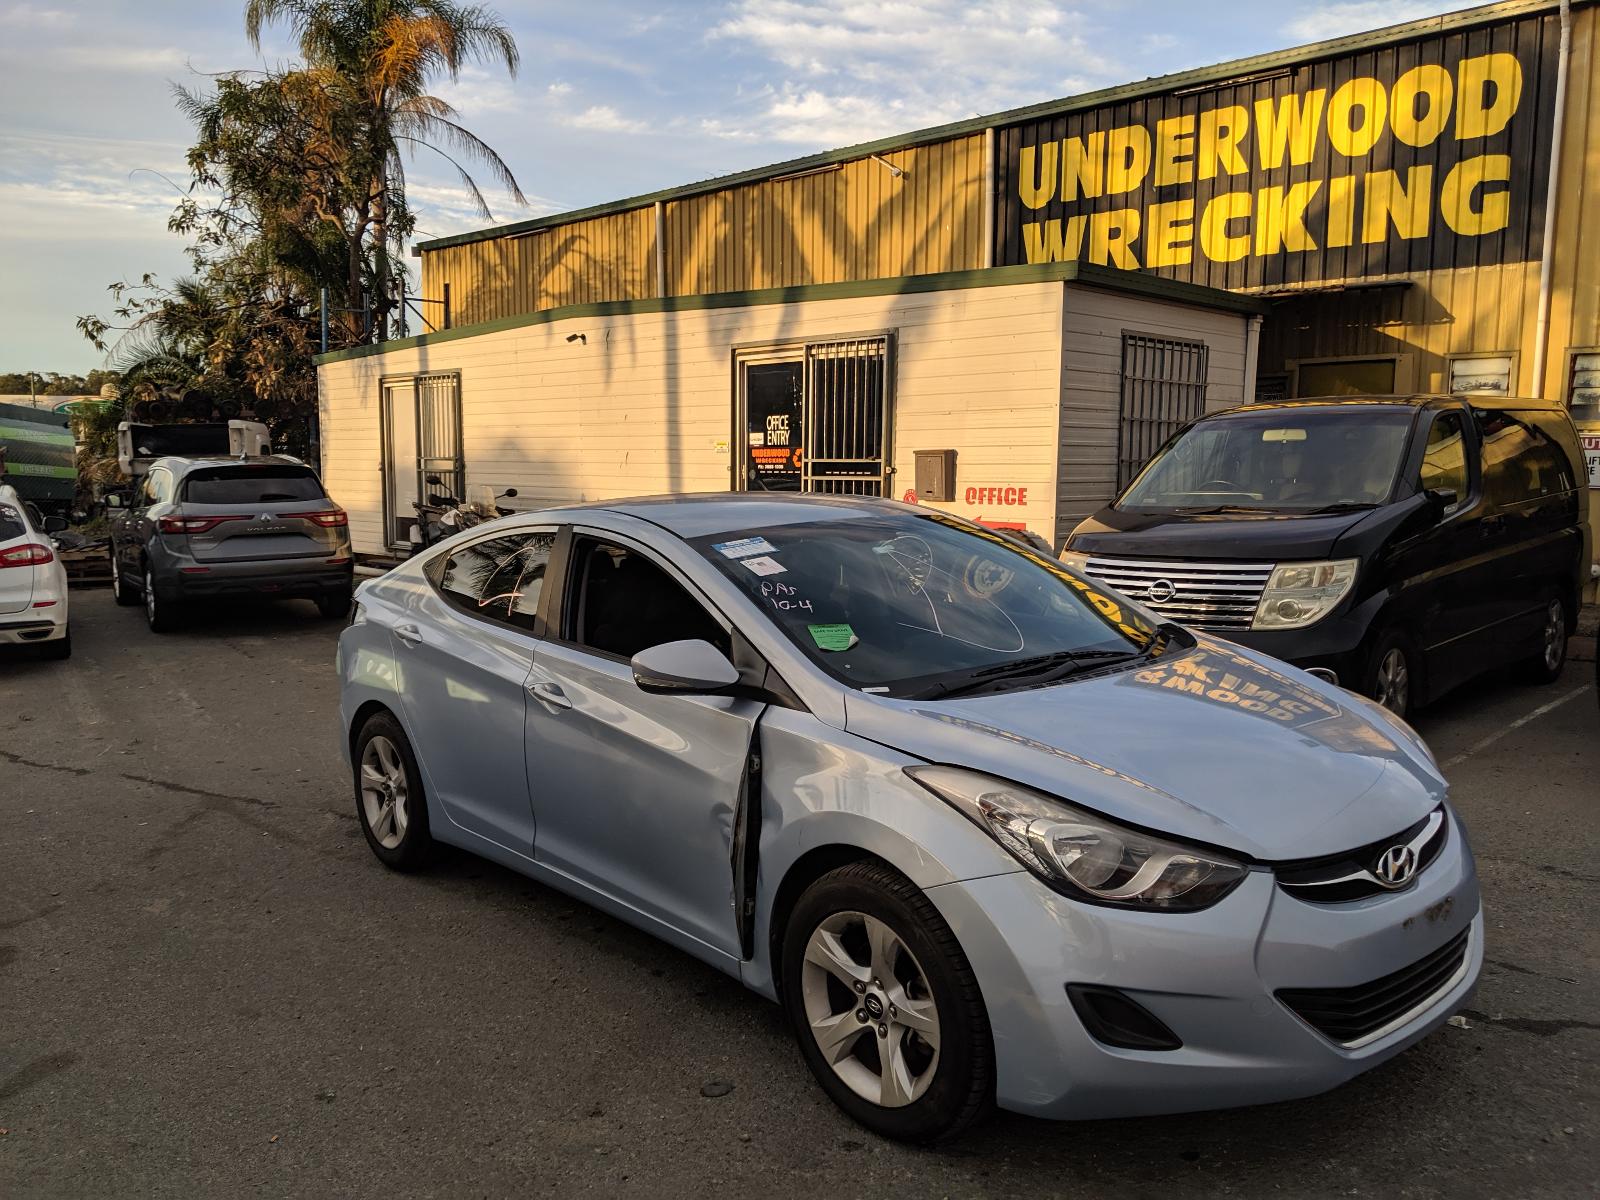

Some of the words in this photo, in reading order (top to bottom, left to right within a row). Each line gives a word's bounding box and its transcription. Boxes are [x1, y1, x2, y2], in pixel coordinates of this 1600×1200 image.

[1019, 52, 1522, 209] UNDERWOOD
[1023, 154, 1511, 270] WRECKING
[766, 414, 789, 431] OFFICE
[767, 430, 791, 446] ENTRY
[752, 448, 790, 457] UNDERWOOD
[965, 486, 1028, 506] OFFICE
[770, 598, 814, 614] 10-4
